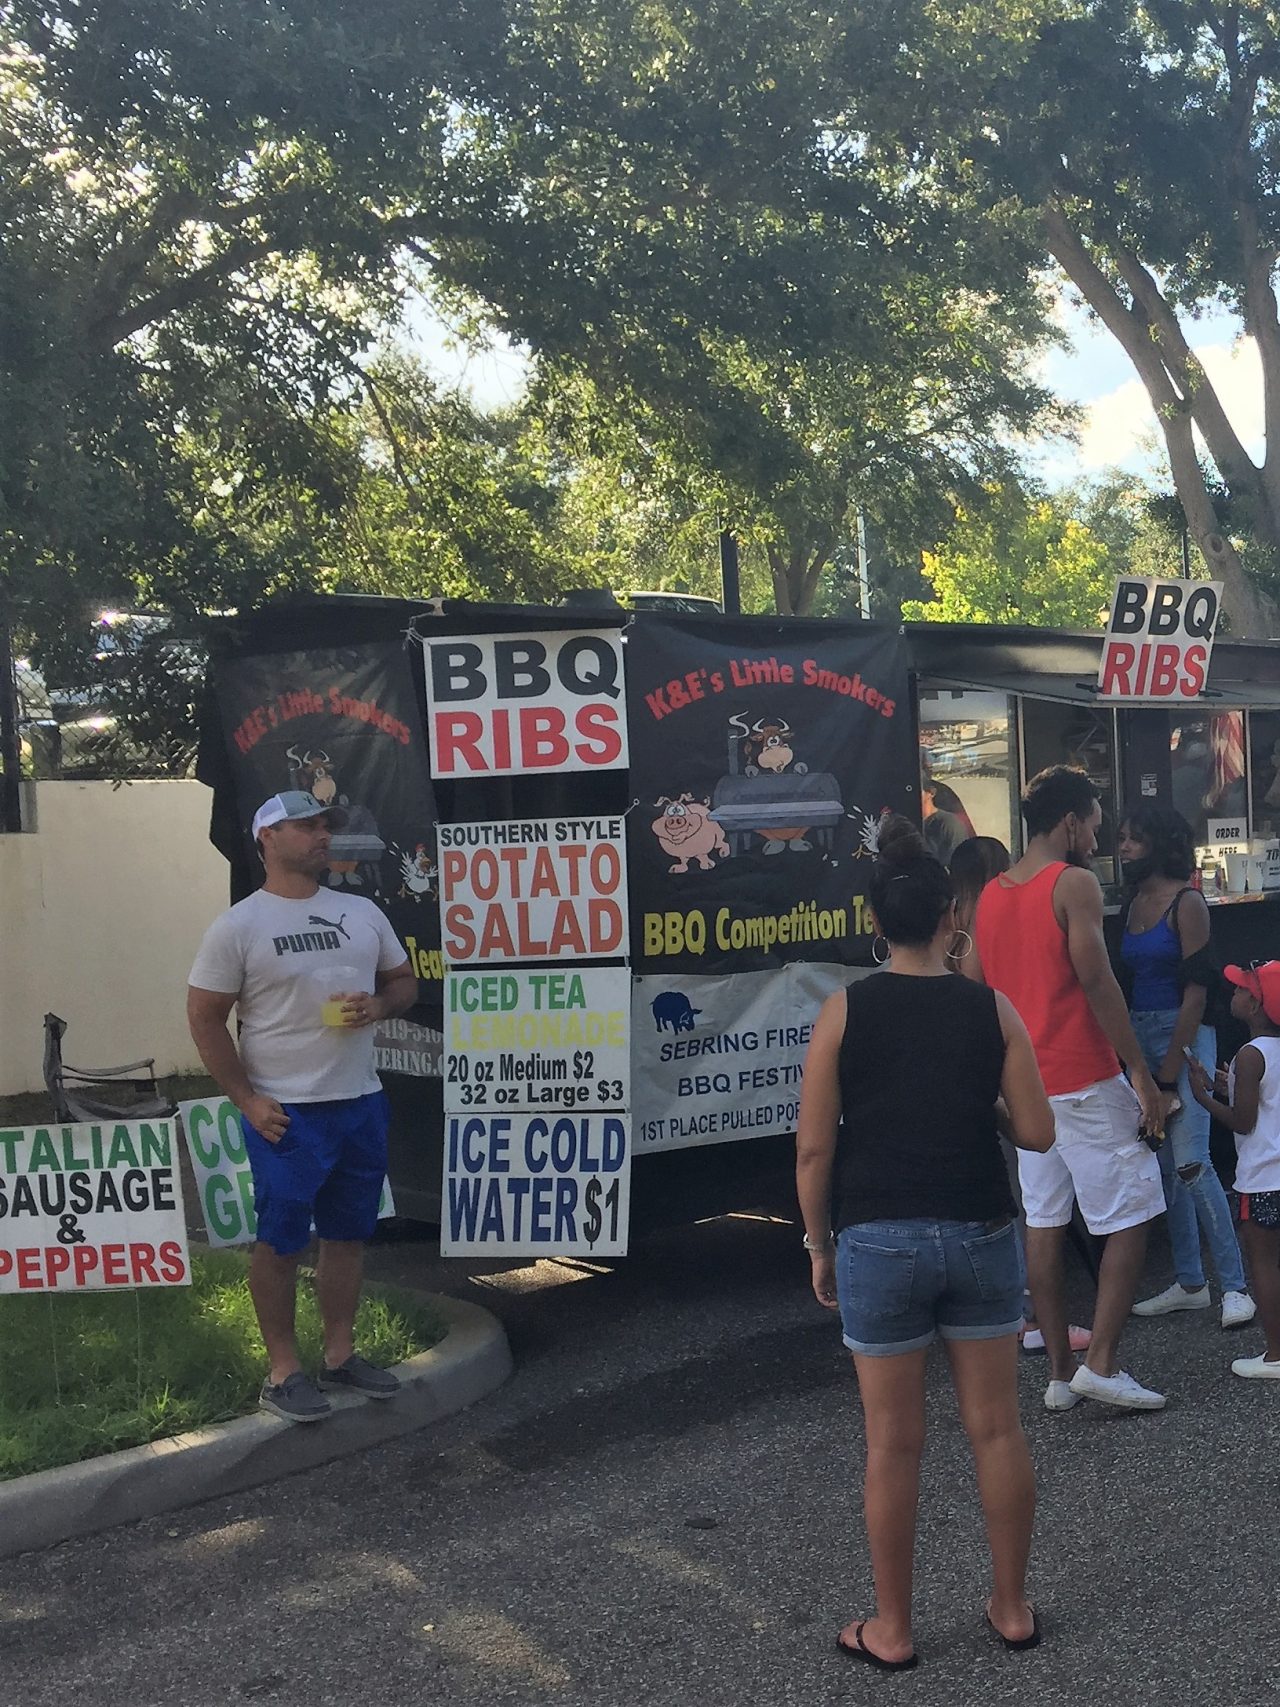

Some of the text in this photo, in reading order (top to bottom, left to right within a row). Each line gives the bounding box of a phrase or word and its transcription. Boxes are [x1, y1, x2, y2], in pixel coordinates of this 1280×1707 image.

[1110, 582, 1218, 642] BBQ
[430, 636, 621, 702] BBQ
[644, 656, 896, 720] K&E's Little Smokers
[1102, 642, 1208, 697] RIBS
[435, 703, 622, 772] RIBS
[441, 820, 621, 847] SOUTHERN STYLE
[1215, 827, 1240, 839] ORDER
[443, 843, 621, 901] POTATO
[272, 931, 340, 956] PUMA
[445, 898, 623, 959] SALAD
[644, 895, 874, 956] BBQ Competition Te
[405, 936, 444, 980] Tea
[451, 974, 587, 1012] ICED TEA
[451, 1011, 625, 1050] LEMONADE
[659, 1023, 815, 1062] SEBRING FIRE
[448, 1050, 594, 1082] 20 oz Medium $2
[677, 1073, 731, 1097] BBQ
[460, 1079, 624, 1107] 32 oz Large $3
[449, 1118, 626, 1173] ICE COLD
[640, 1120, 665, 1142] 1ST
[670, 1113, 717, 1138] PLACE
[721, 1105, 773, 1133] PULLED
[0, 1123, 172, 1174] TALIAN
[0, 1168, 176, 1217] AUSAGE
[448, 1175, 619, 1250] WATER $1
[56, 1214, 86, 1244] &
